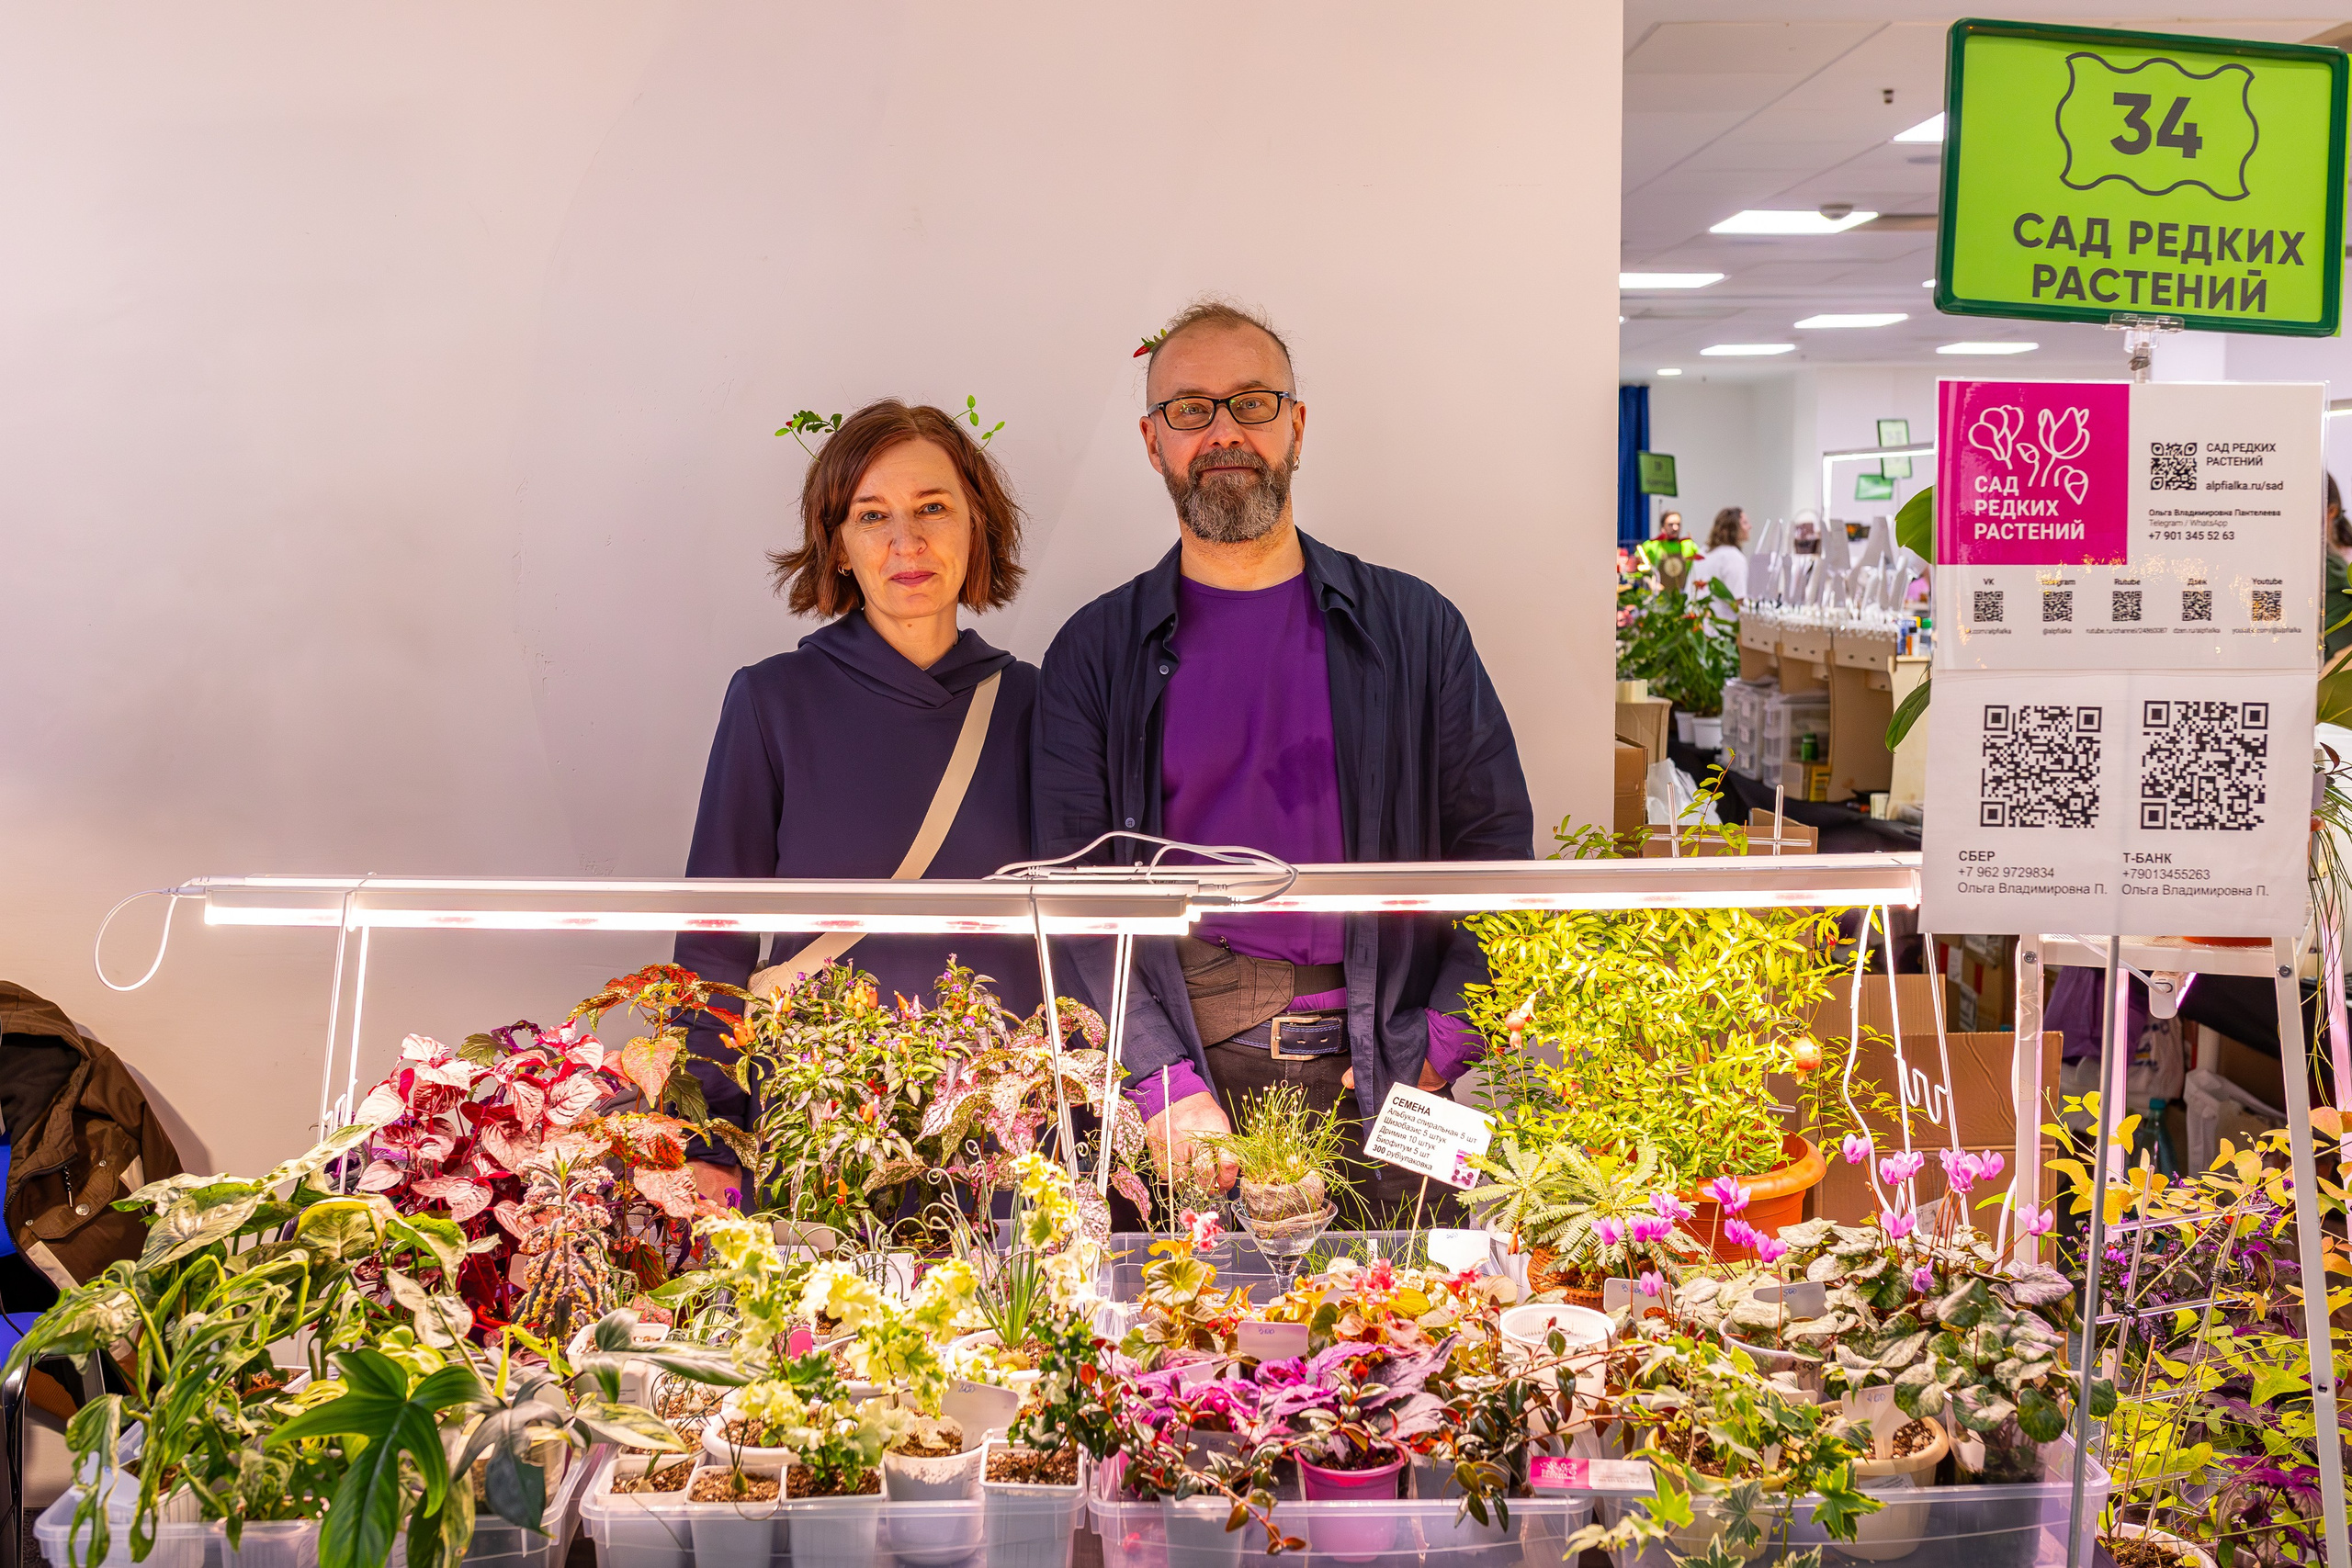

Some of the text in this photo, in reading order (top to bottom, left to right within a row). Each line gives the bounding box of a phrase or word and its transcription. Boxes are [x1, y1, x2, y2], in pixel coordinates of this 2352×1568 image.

[2109, 92, 2203, 159] 34
[2013, 212, 2305, 266] САД РЕДКИХ
[2031, 263, 2267, 313] РАСТЕНИЙ
[2207, 443, 2277, 454] САД РЕДКИХ
[2206, 455, 2263, 467] РАСТЕНИЙ
[1973, 476, 2019, 497] САД
[2206, 480, 2284, 492] alpfialka.ru/sad
[1973, 499, 2060, 520] РЕДКИХ
[2148, 509, 2172, 517] Ольга
[2174, 509, 2233, 518] Владимировна
[1973, 518, 2086, 541] РАСТЕНИЙ
[2148, 519, 2184, 528] Telegram
[2148, 531, 2235, 540] +7 901 345 52 63
[1958, 850, 1996, 863] СБЕР
[2123, 852, 2173, 864] Т-БАНК
[1958, 866, 2054, 878] +7 962 9729834
[2122, 868, 2211, 881] +79013455263
[1958, 882, 2109, 897] Ольга Владимировна П.
[2121, 884, 2269, 898] Ольга Владимировна П.
[1392, 1096, 1430, 1116] СЕМЕНА
[1384, 1116, 1447, 1145] Шизобазис 5 штук
[1387, 1107, 1477, 1145] Альбука спиральная 5 шт
[1378, 1125, 1436, 1151] Дримия 10 штук
[1372, 1144, 1386, 1155] 300
[1375, 1134, 1430, 1159] Биофитум 5 шт
